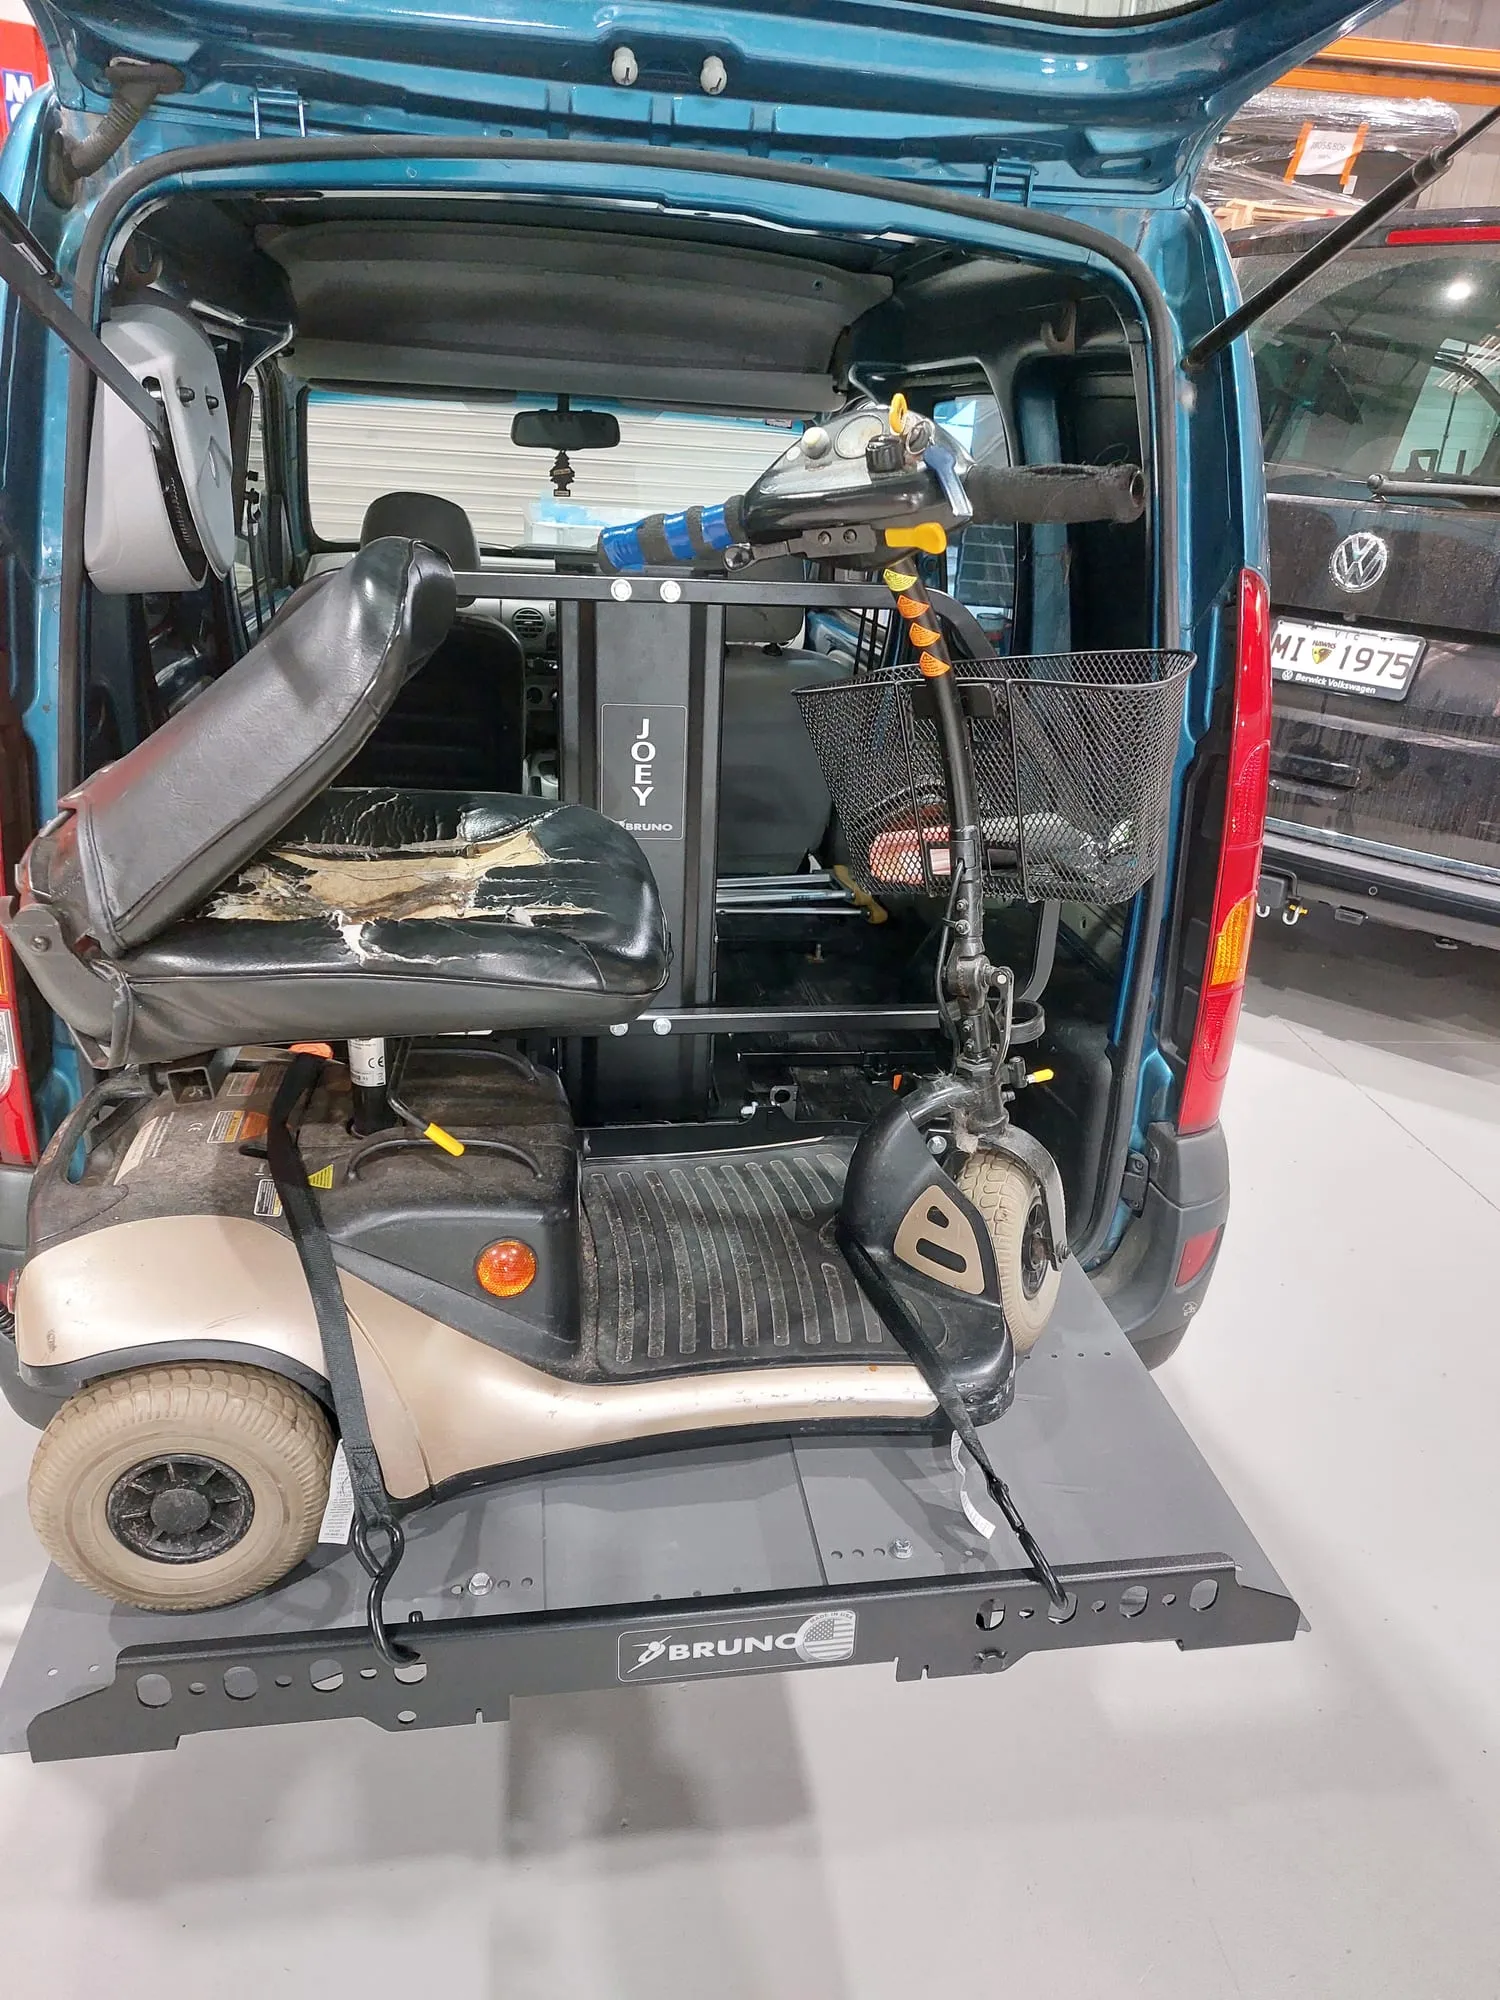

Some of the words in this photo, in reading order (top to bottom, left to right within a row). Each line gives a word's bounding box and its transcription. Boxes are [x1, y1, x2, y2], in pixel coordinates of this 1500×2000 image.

[1335, 630, 1360, 641] VIC
[1271, 633, 1305, 662] MI
[1339, 645, 1413, 680] 1975
[1295, 673, 1327, 686] Berwick
[1328, 676, 1376, 694] Volkswagen
[631, 718, 656, 807] JOEY
[625, 823, 673, 832] BRUNO
[668, 1632, 799, 1661] BRUNO
